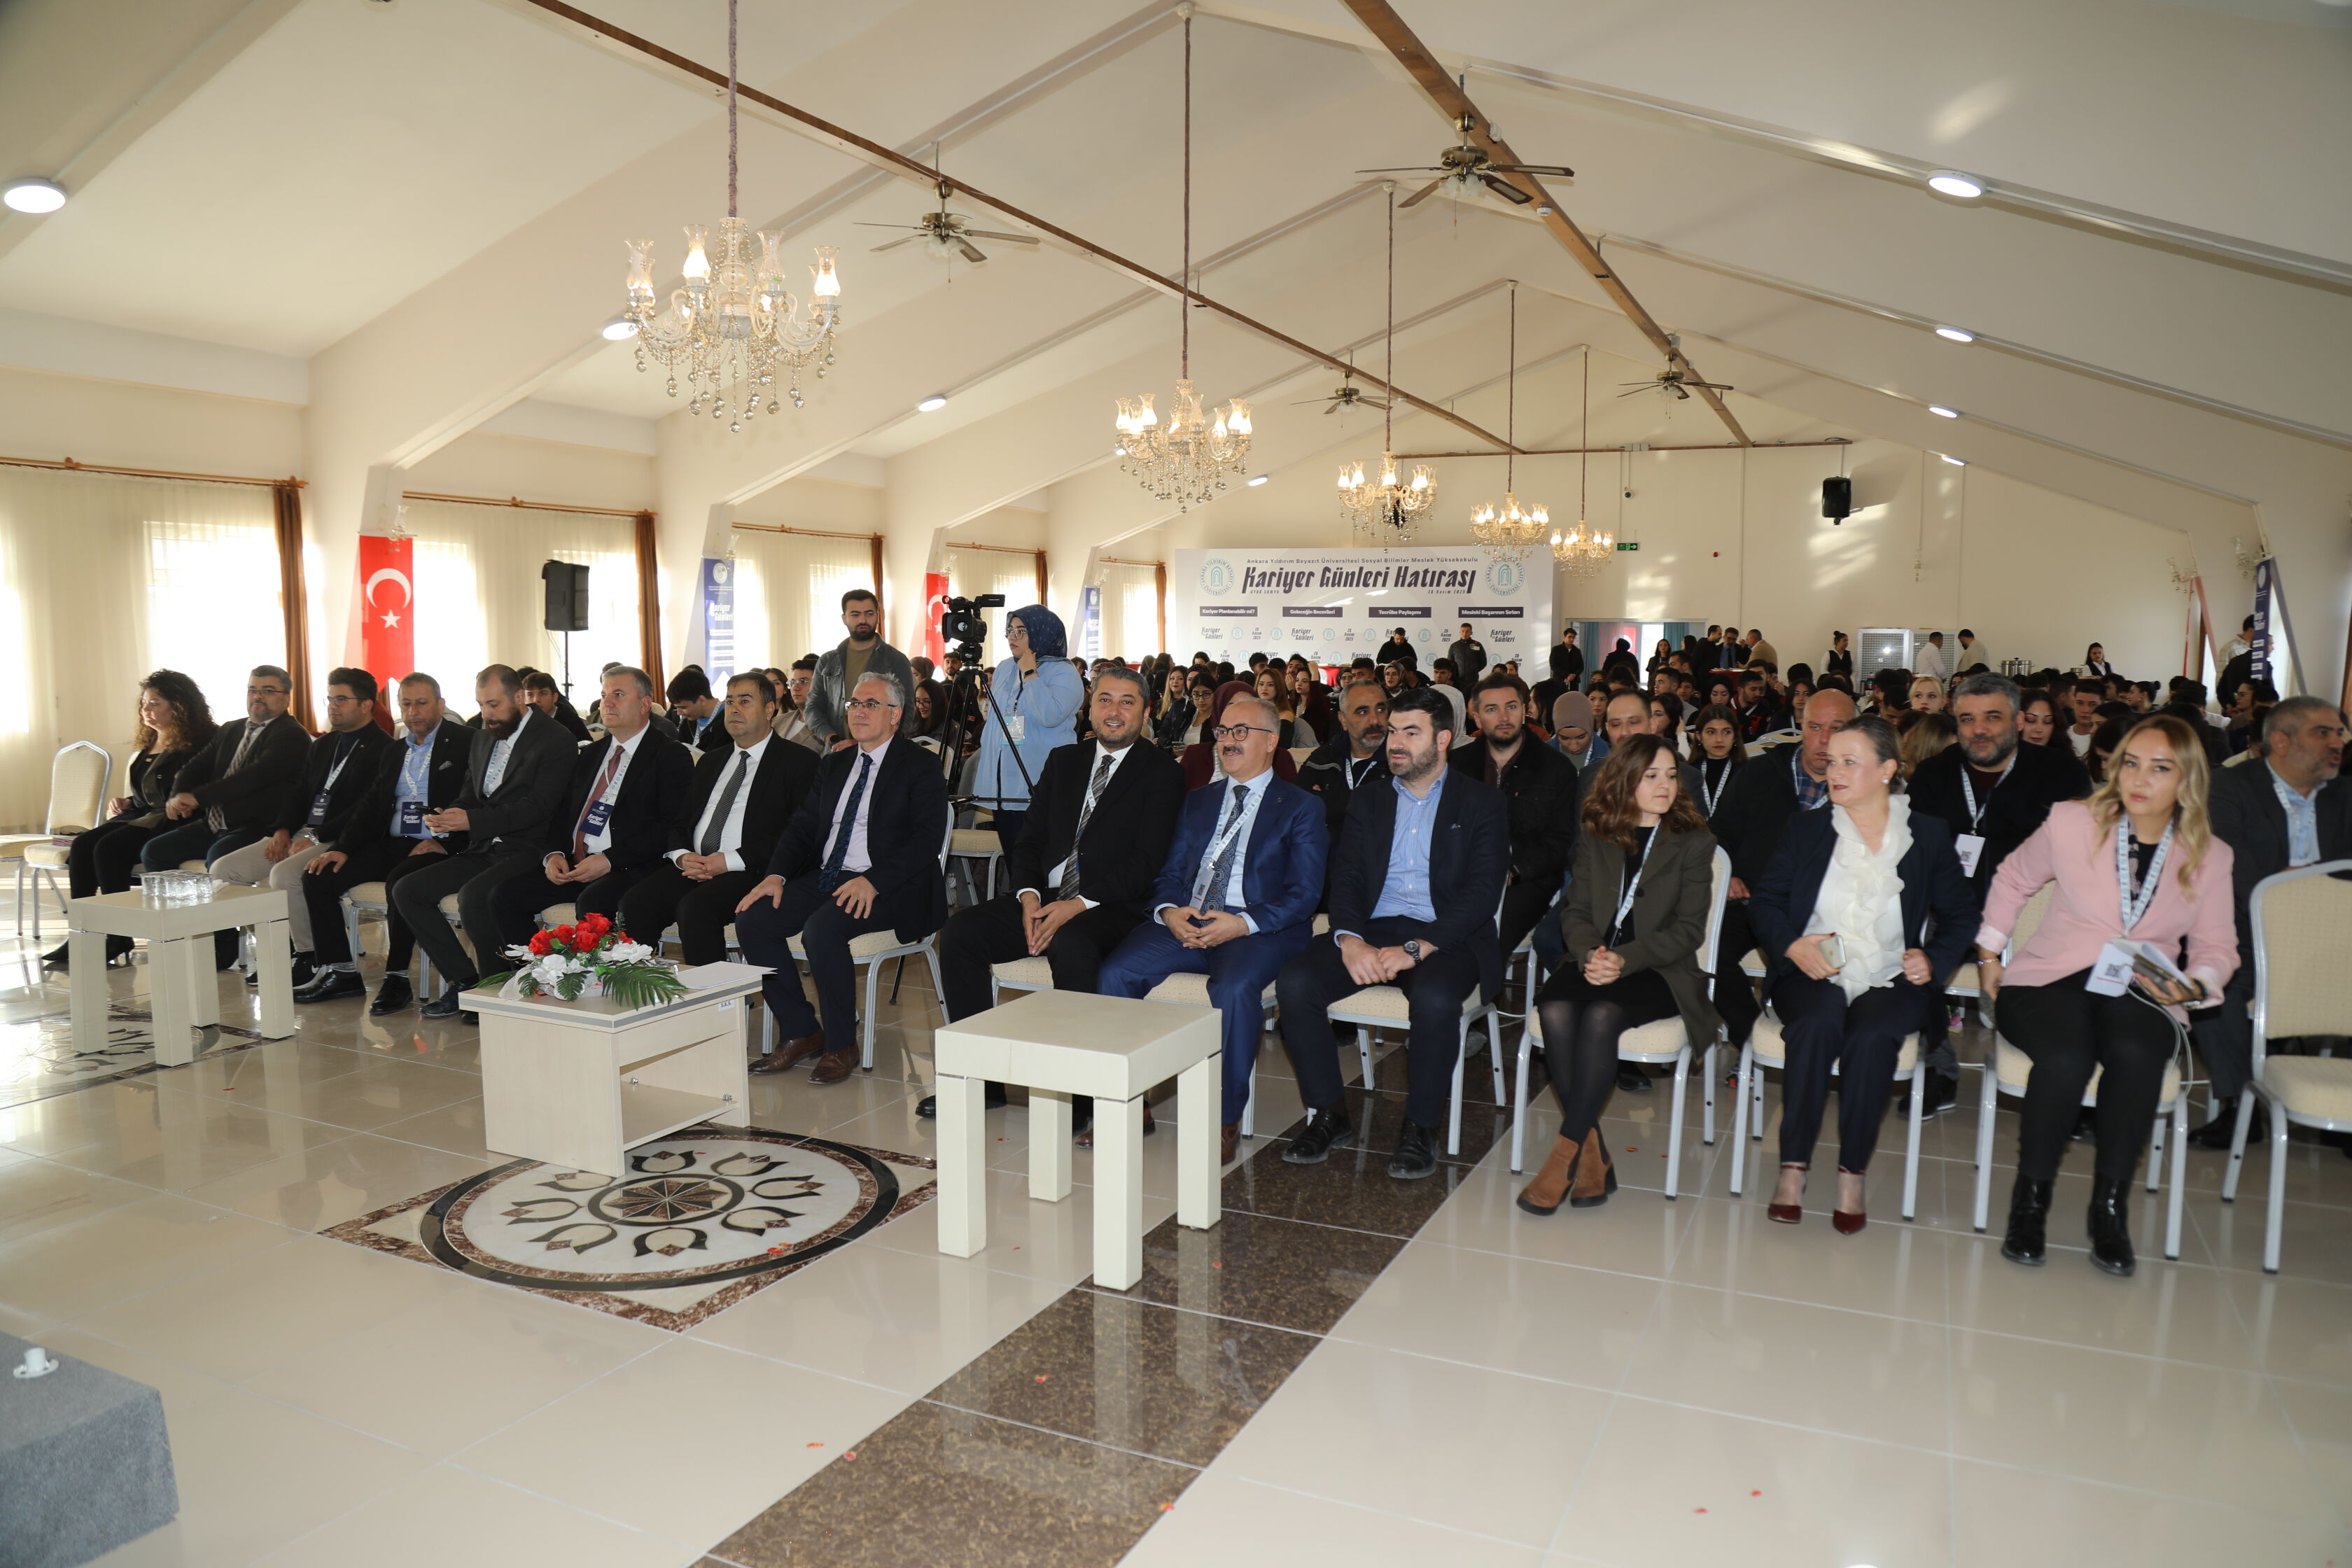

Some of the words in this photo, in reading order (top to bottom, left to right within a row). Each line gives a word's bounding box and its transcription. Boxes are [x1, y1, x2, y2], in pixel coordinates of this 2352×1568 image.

[1241, 566, 1315, 594] Kariyer
[1319, 566, 1390, 588] Günleri
[1394, 566, 1476, 594] Hatırası
